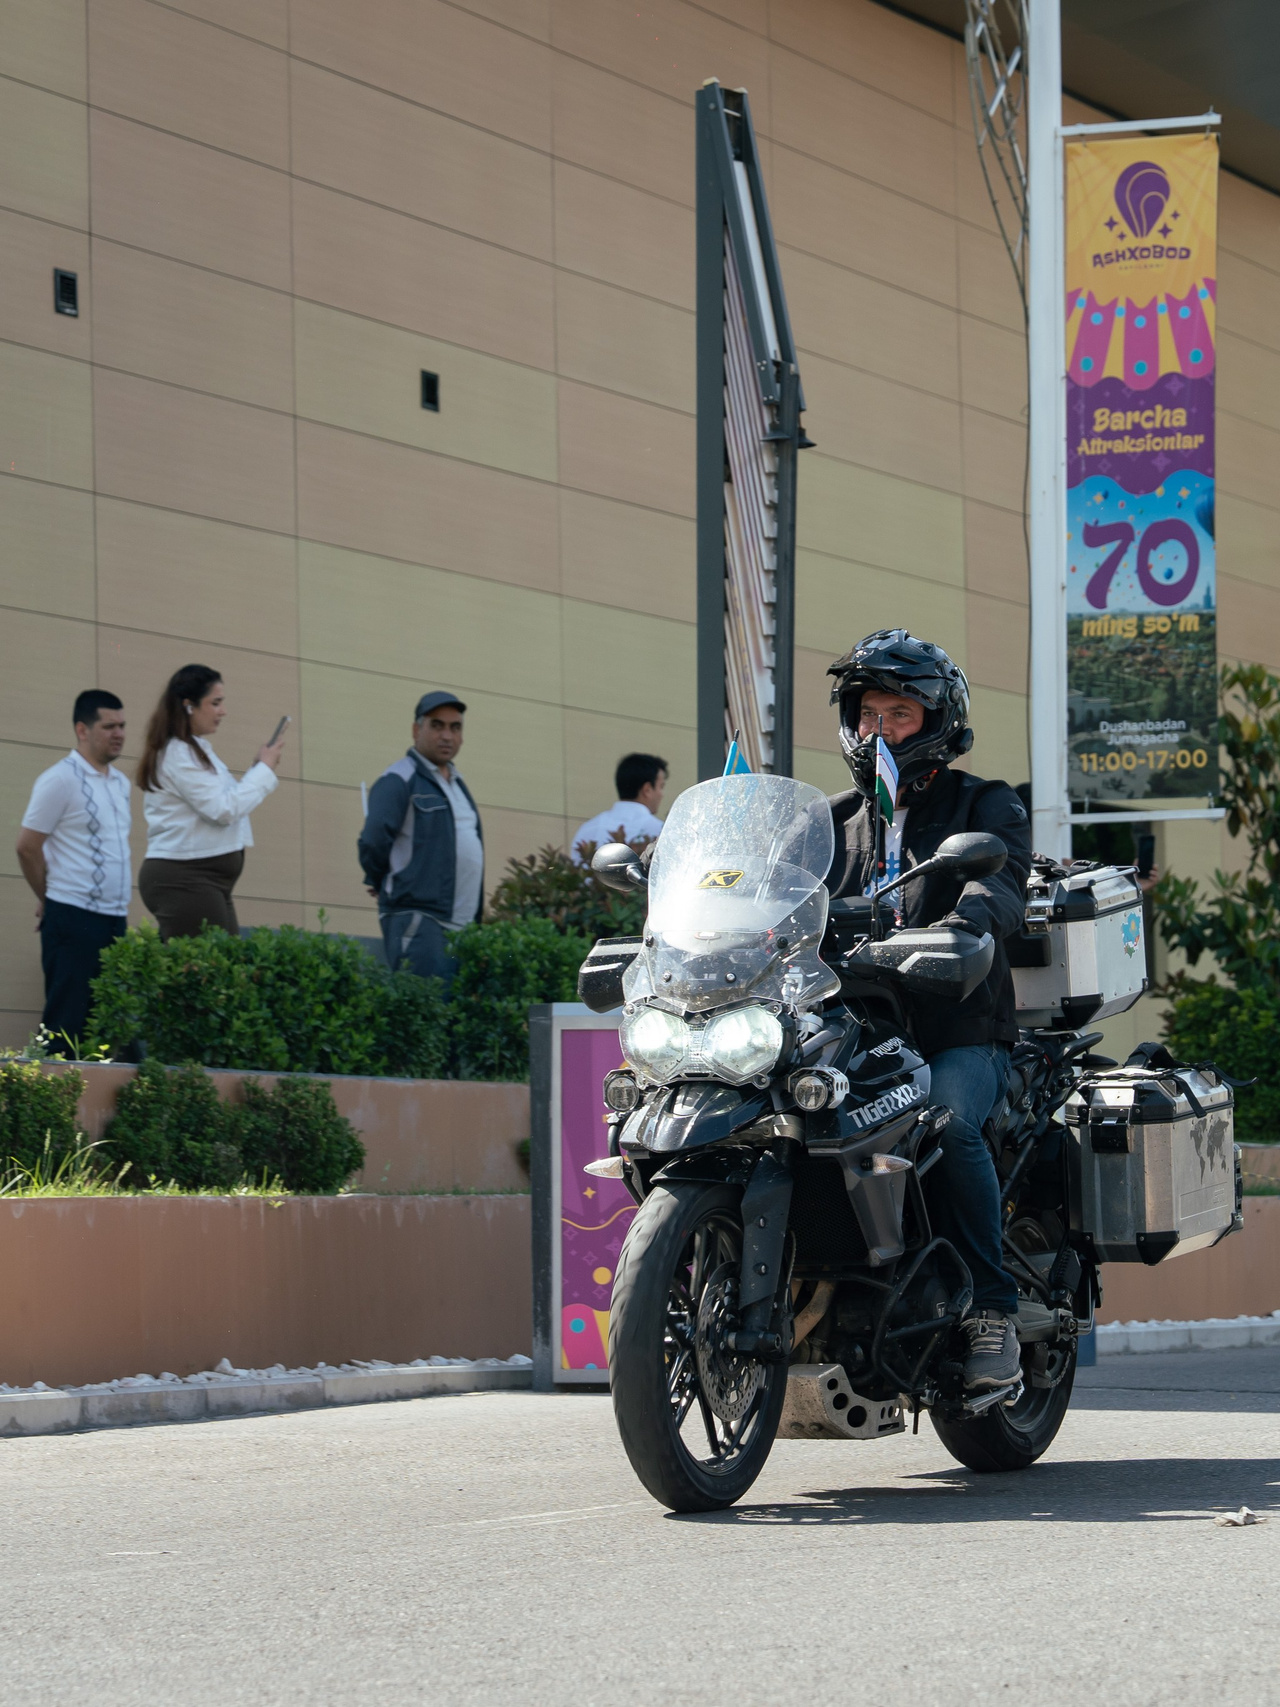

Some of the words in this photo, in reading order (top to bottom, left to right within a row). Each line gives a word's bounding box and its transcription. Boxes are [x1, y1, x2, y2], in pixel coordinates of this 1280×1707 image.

[1092, 244, 1191, 268] ASHXOBOD
[1093, 404, 1187, 433] Barcha
[1082, 517, 1200, 610] 70
[1082, 614, 1138, 638] ming
[1100, 718, 1186, 734] Dushanbadan
[1107, 732, 1180, 746] Jumagacha
[1080, 748, 1208, 773] 11:00-17:00
[868, 1036, 906, 1058] TRIUMPH
